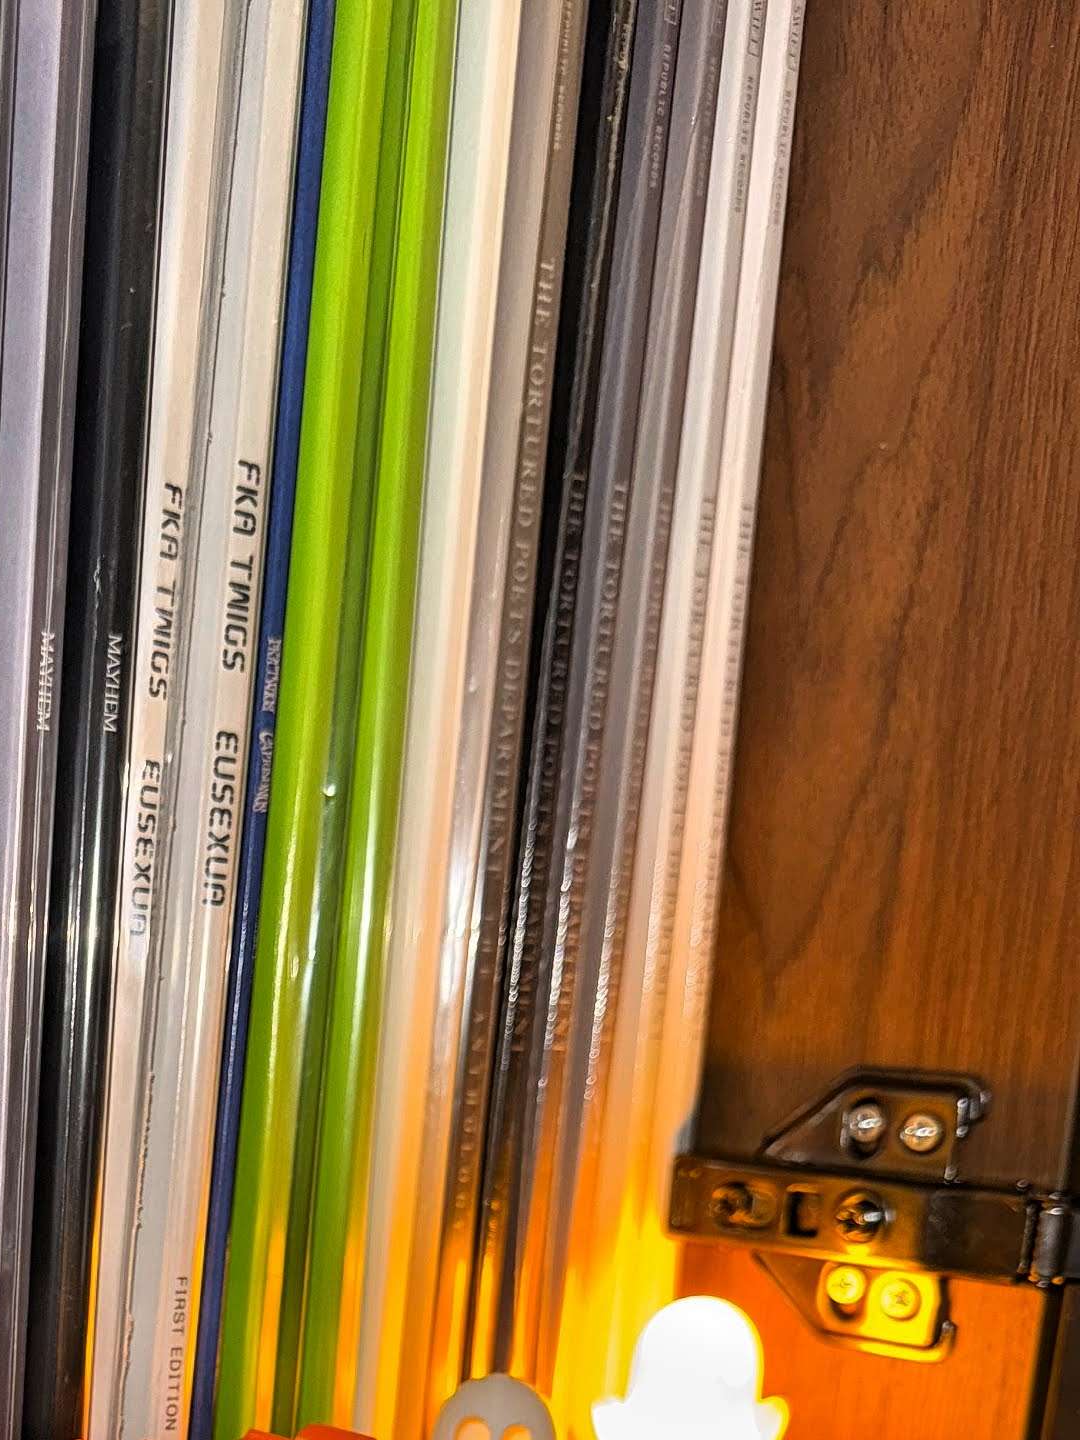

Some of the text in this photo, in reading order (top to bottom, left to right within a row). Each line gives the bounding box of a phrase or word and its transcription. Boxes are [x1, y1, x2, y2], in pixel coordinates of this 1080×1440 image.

[533, 256, 556, 329] THE
[518, 341, 550, 528] TORTURED
[505, 538, 531, 645] POETS
[35, 630, 56, 733] MAYHEM
[102, 633, 123, 734] MAYHEM
[129, 481, 183, 937] FKA TWIGS EUSEXUA
[202, 459, 261, 908] FKA TWIGS EUSEXUA
[487, 658, 522, 880] DEPARTMENT
[164, 1275, 189, 1432] FIRST EDITION
